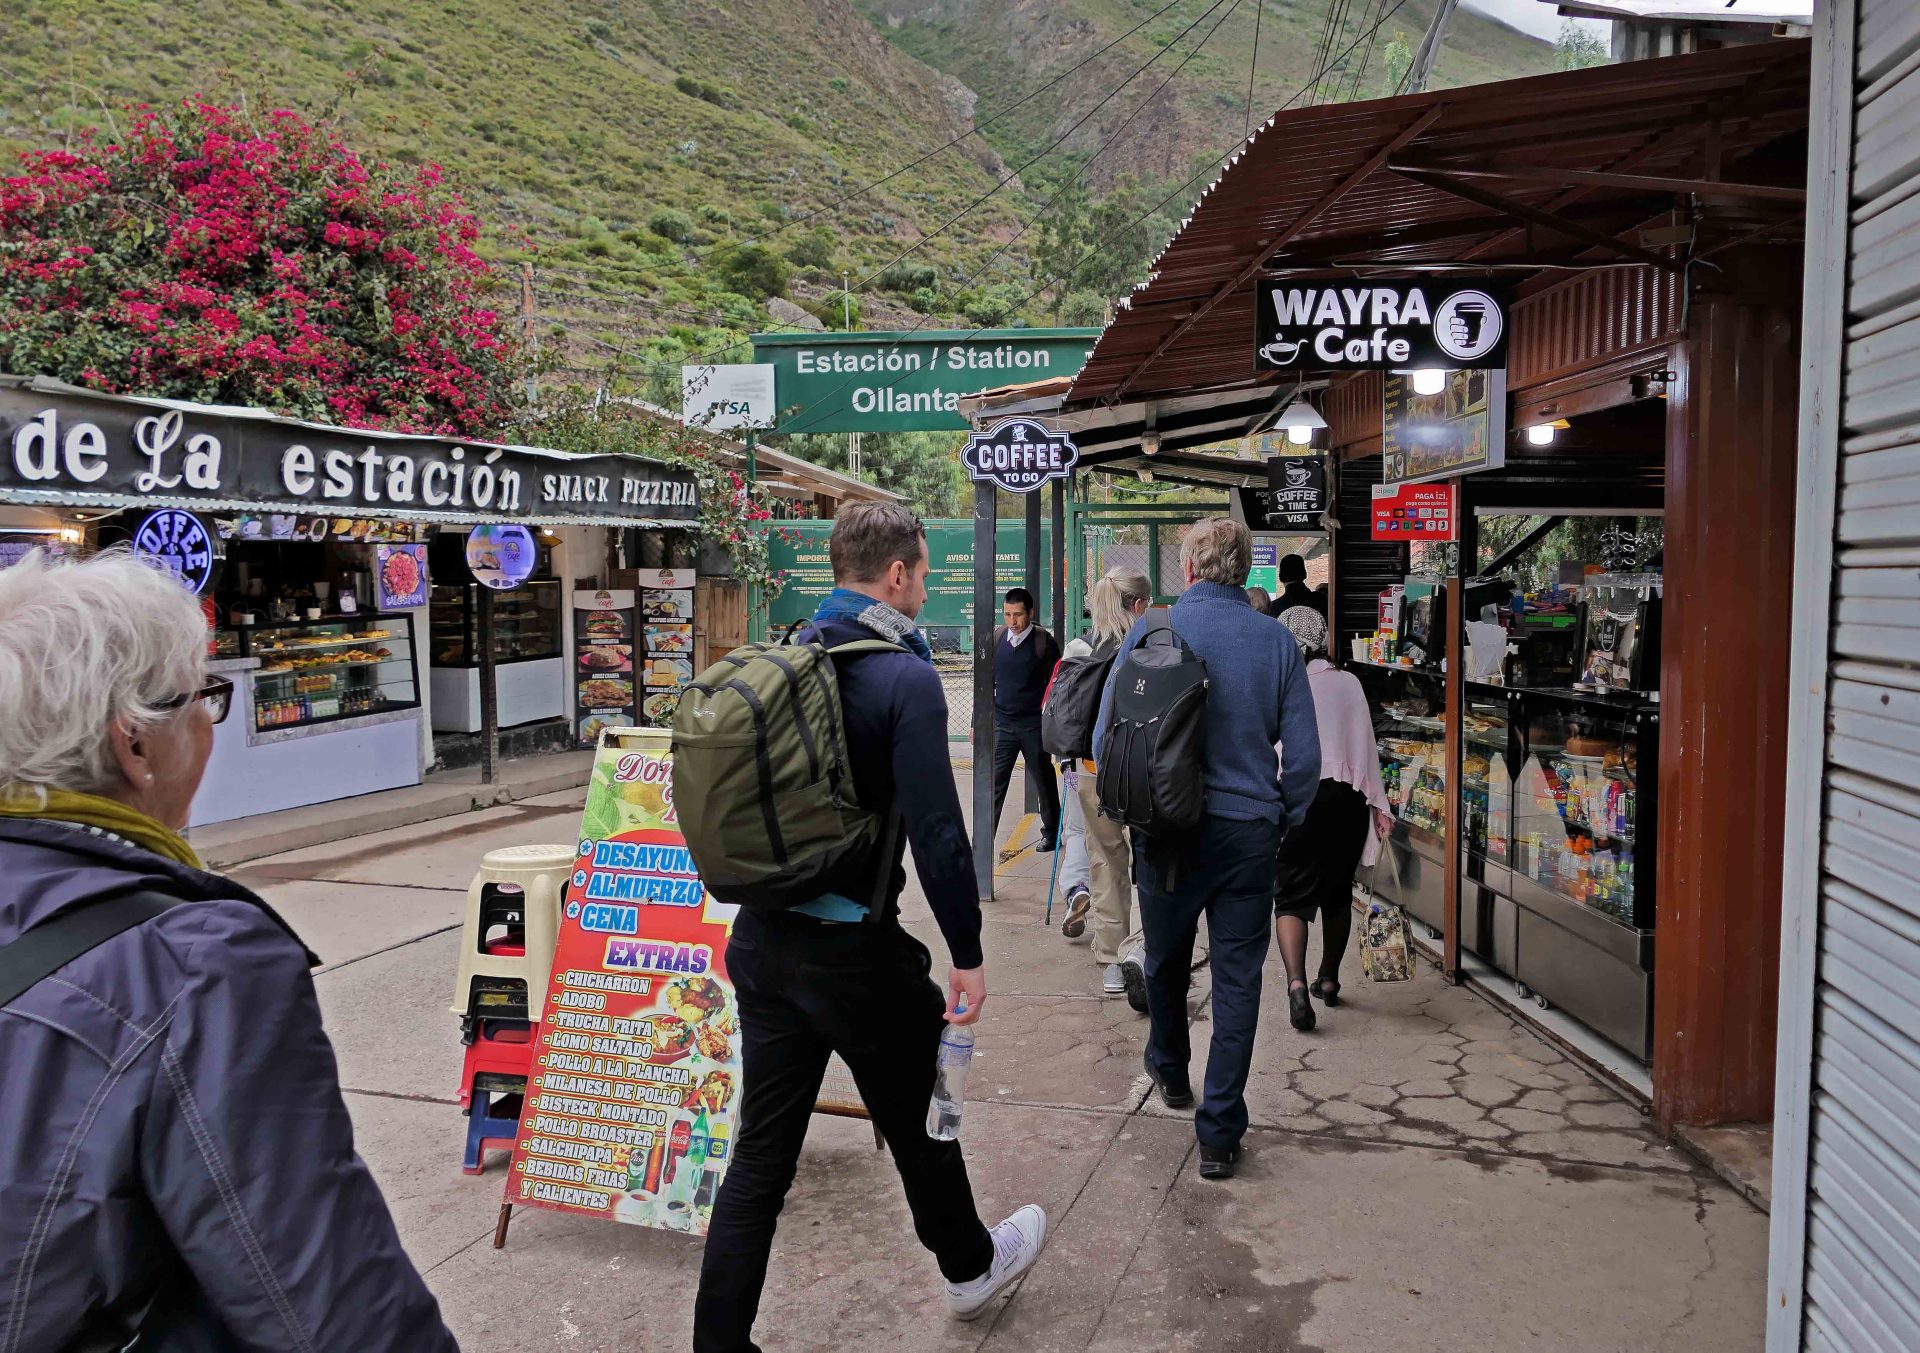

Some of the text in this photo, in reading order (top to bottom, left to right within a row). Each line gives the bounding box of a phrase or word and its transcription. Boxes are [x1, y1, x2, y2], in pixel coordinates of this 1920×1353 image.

[1272, 288, 1431, 326] WAYRA
[1314, 327, 1411, 363] Cafe
[796, 346, 1051, 374] Estación / Station
[12, 408, 696, 511] de La estación SNACK PIZZERIA
[978, 443, 1062, 471] COFFEE
[1004, 472, 1039, 483] TO GO
[1277, 490, 1318, 503] COFFEE
[1288, 501, 1308, 511] TIME
[1415, 492, 1434, 500] PAGA
[1287, 514, 1309, 523] VISA
[946, 554, 967, 562] AVISO
[587, 873, 703, 905] ALMUERZO
[582, 905, 637, 932] CENA
[606, 941, 709, 974] EXTRAS
[565, 970, 650, 994] CHICHARRON
[560, 990, 605, 1010] ADOBO
[557, 1011, 652, 1037] TRUCHA FRITA
[551, 1032, 652, 1058] LOMO SALTADO
[547, 1053, 690, 1085] POLLO A LA PLANCHA
[543, 1074, 681, 1106] MILANESA DE POLLO
[539, 1095, 667, 1127] BISTECK MONTADO
[534, 1116, 653, 1147] POLLO BROASTER
[530, 1138, 613, 1164] SALCHIPAPA
[525, 1158, 629, 1189] BEBIDAS FRIAS
[521, 1180, 610, 1209] Y CALIENTES
